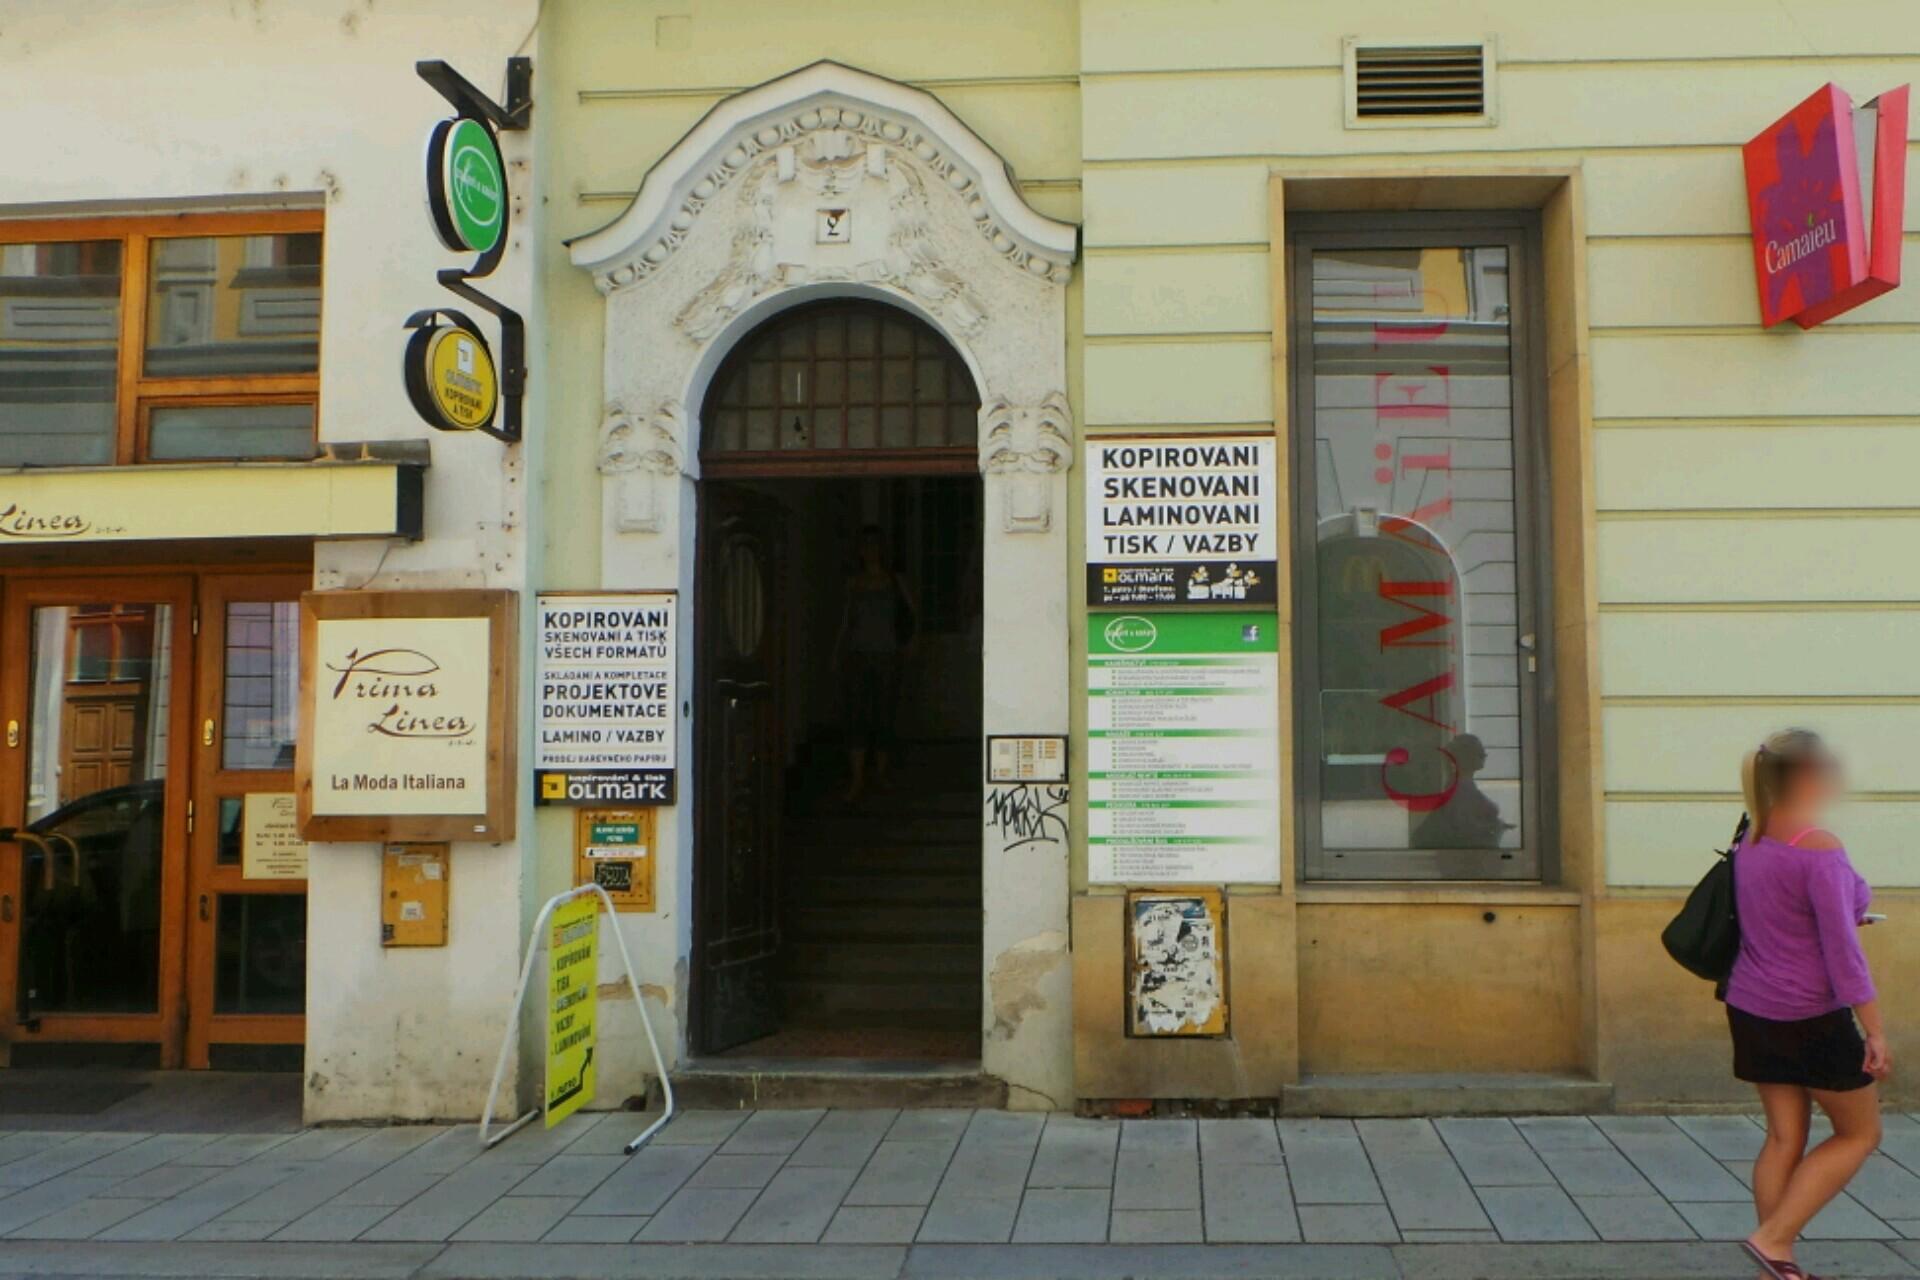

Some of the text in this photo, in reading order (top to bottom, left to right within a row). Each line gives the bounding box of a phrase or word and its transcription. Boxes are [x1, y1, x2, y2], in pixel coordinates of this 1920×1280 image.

[1104, 533, 1259, 554] TISK / VAZBY
[624, 631, 633, 641] A
[638, 630, 667, 641] TISK
[545, 643, 592, 658] VŠECH
[325, 648, 440, 700] Prima
[543, 704, 667, 718] DOKUMENTACE
[367, 703, 477, 738] Linea
[543, 730, 665, 743] LAMINO / VAZBY
[331, 774, 466, 790] La Moda Italiana
